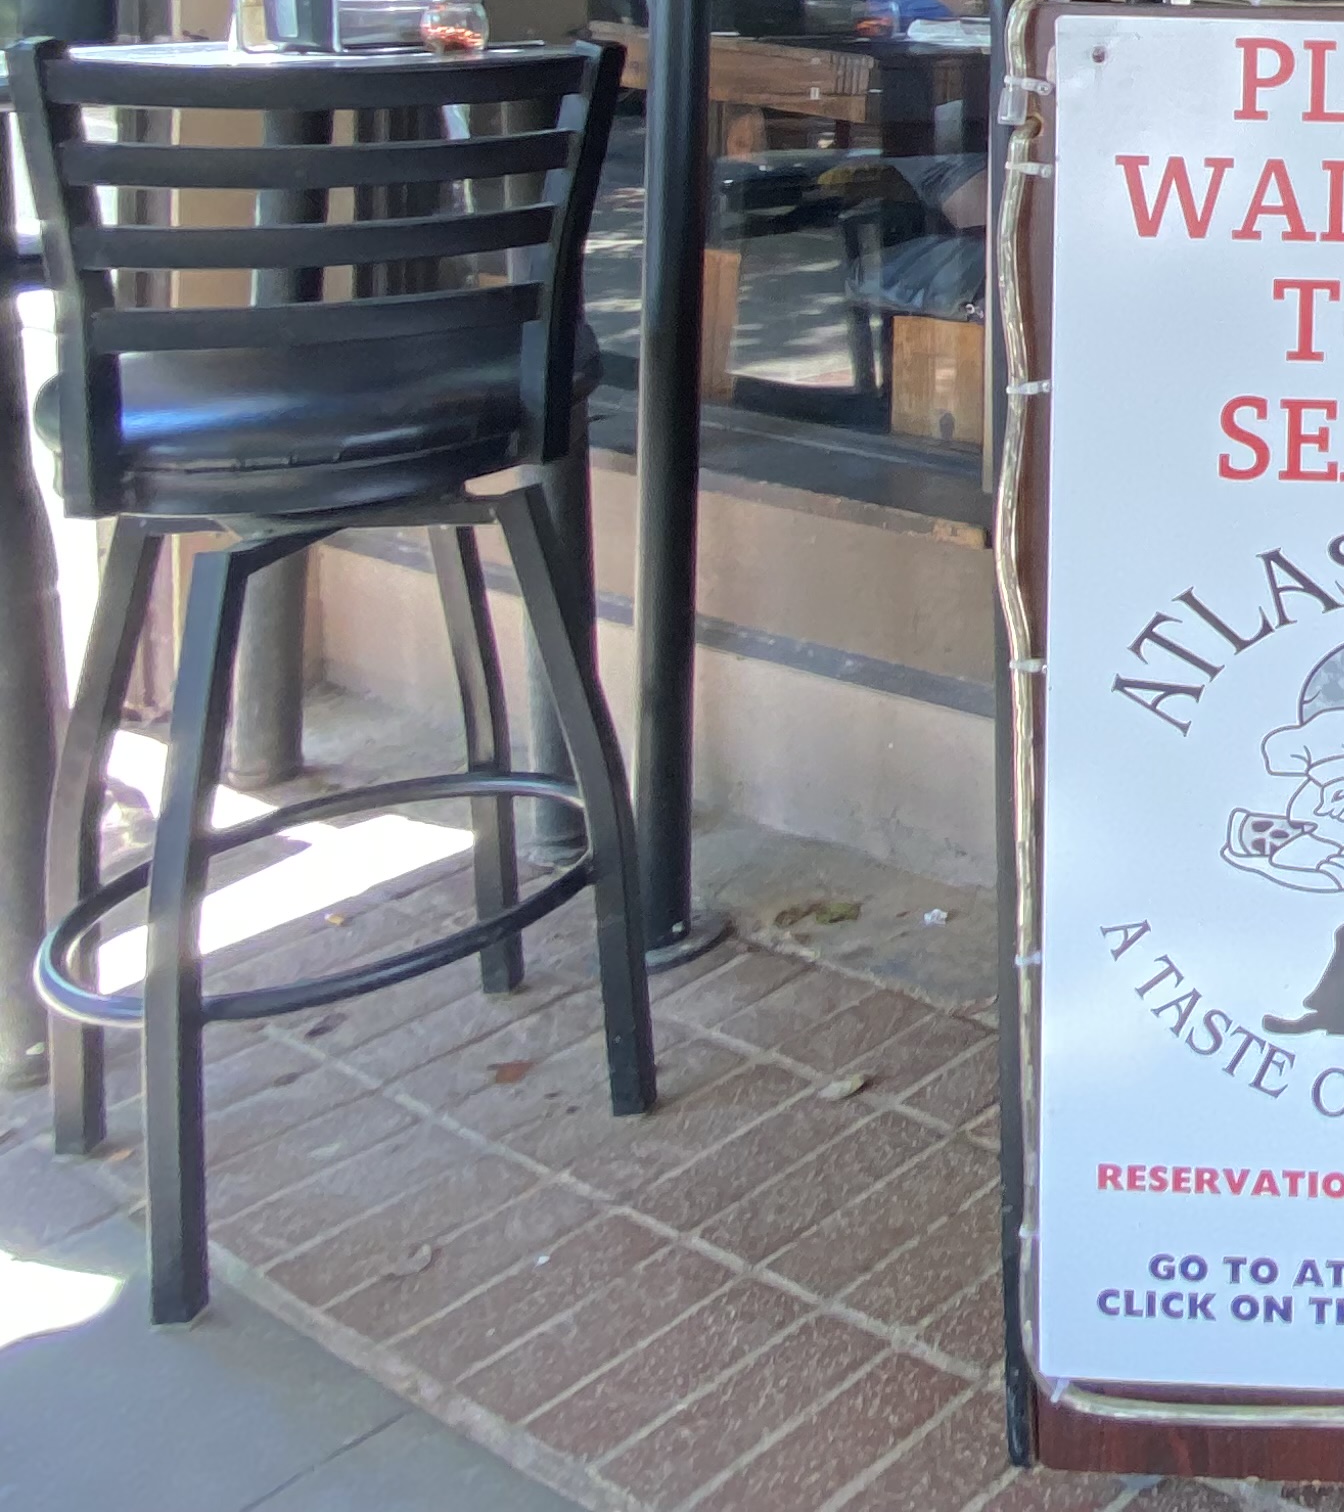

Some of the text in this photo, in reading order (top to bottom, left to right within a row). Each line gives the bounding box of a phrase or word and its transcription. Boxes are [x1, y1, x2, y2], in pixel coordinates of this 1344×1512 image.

[1100, 918, 1152, 961] A
[1134, 954, 1296, 1099] TASTE
[1148, 1253, 1209, 1284] GO
[1223, 1256, 1279, 1286] TO
[1096, 1289, 1217, 1321] CLICK
[1230, 1294, 1293, 1324] ON
